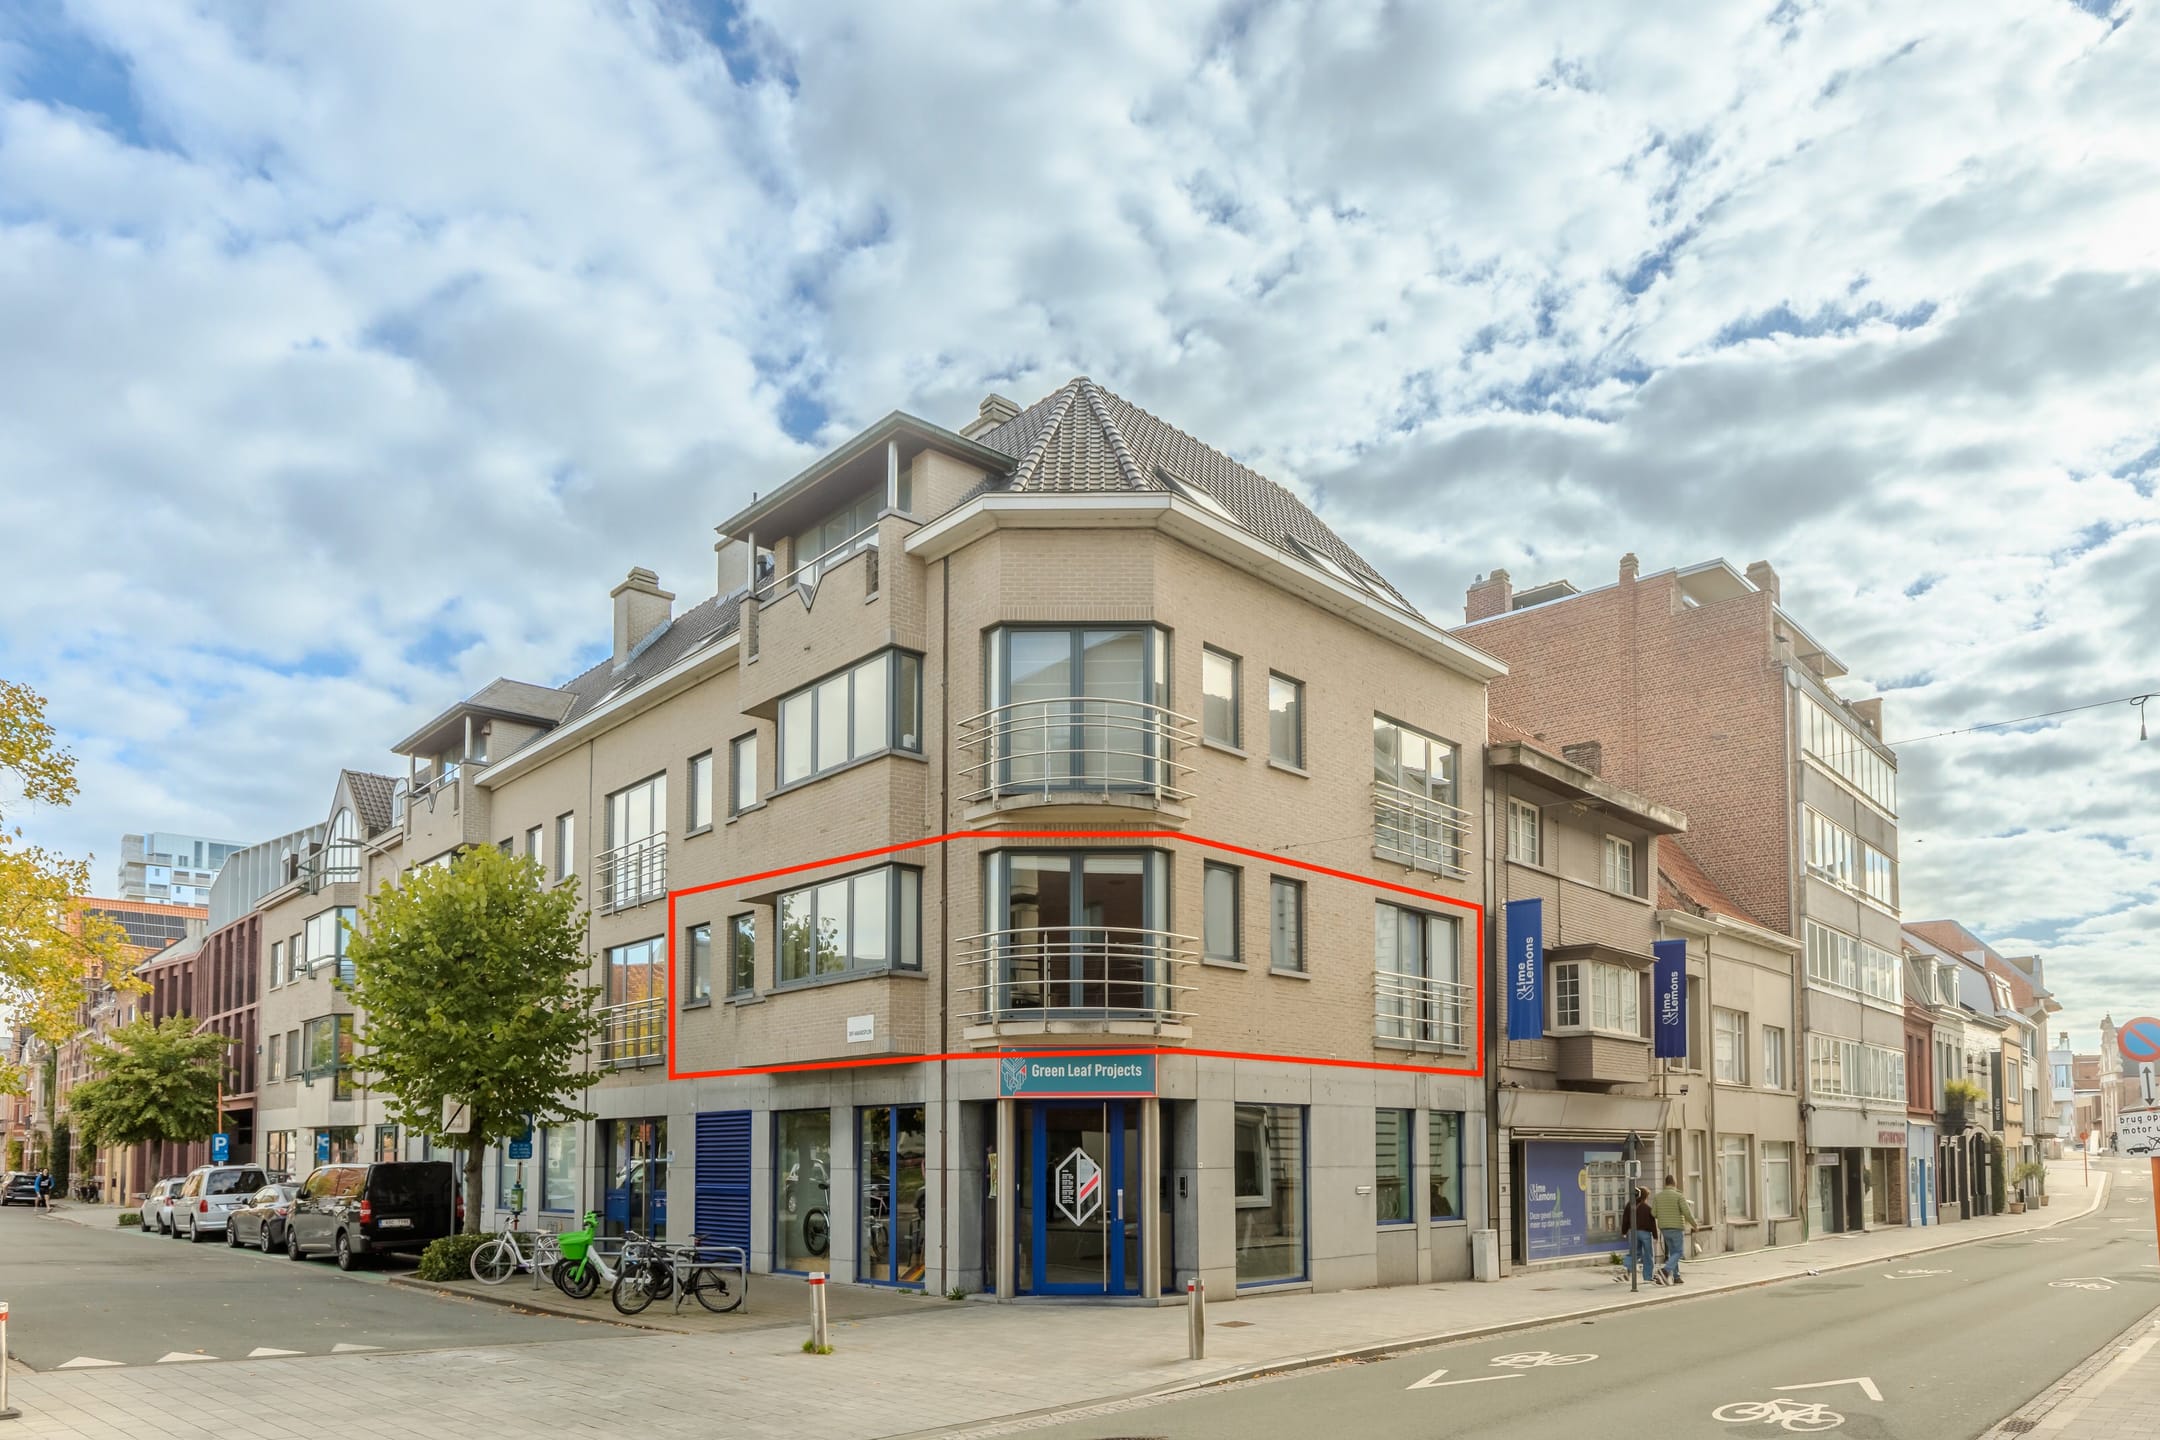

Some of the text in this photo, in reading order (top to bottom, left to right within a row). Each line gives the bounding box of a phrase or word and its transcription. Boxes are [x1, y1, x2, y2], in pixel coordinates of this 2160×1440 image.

[1516, 962, 1526, 992] Lime
[1662, 992, 1671, 1018] Lime
[1032, 1063, 1142, 1079] Green Leaf Projects
[2120, 1114, 2160, 1124] brug op
[2122, 1126, 2151, 1135] motor
[215, 1136, 227, 1151] P
